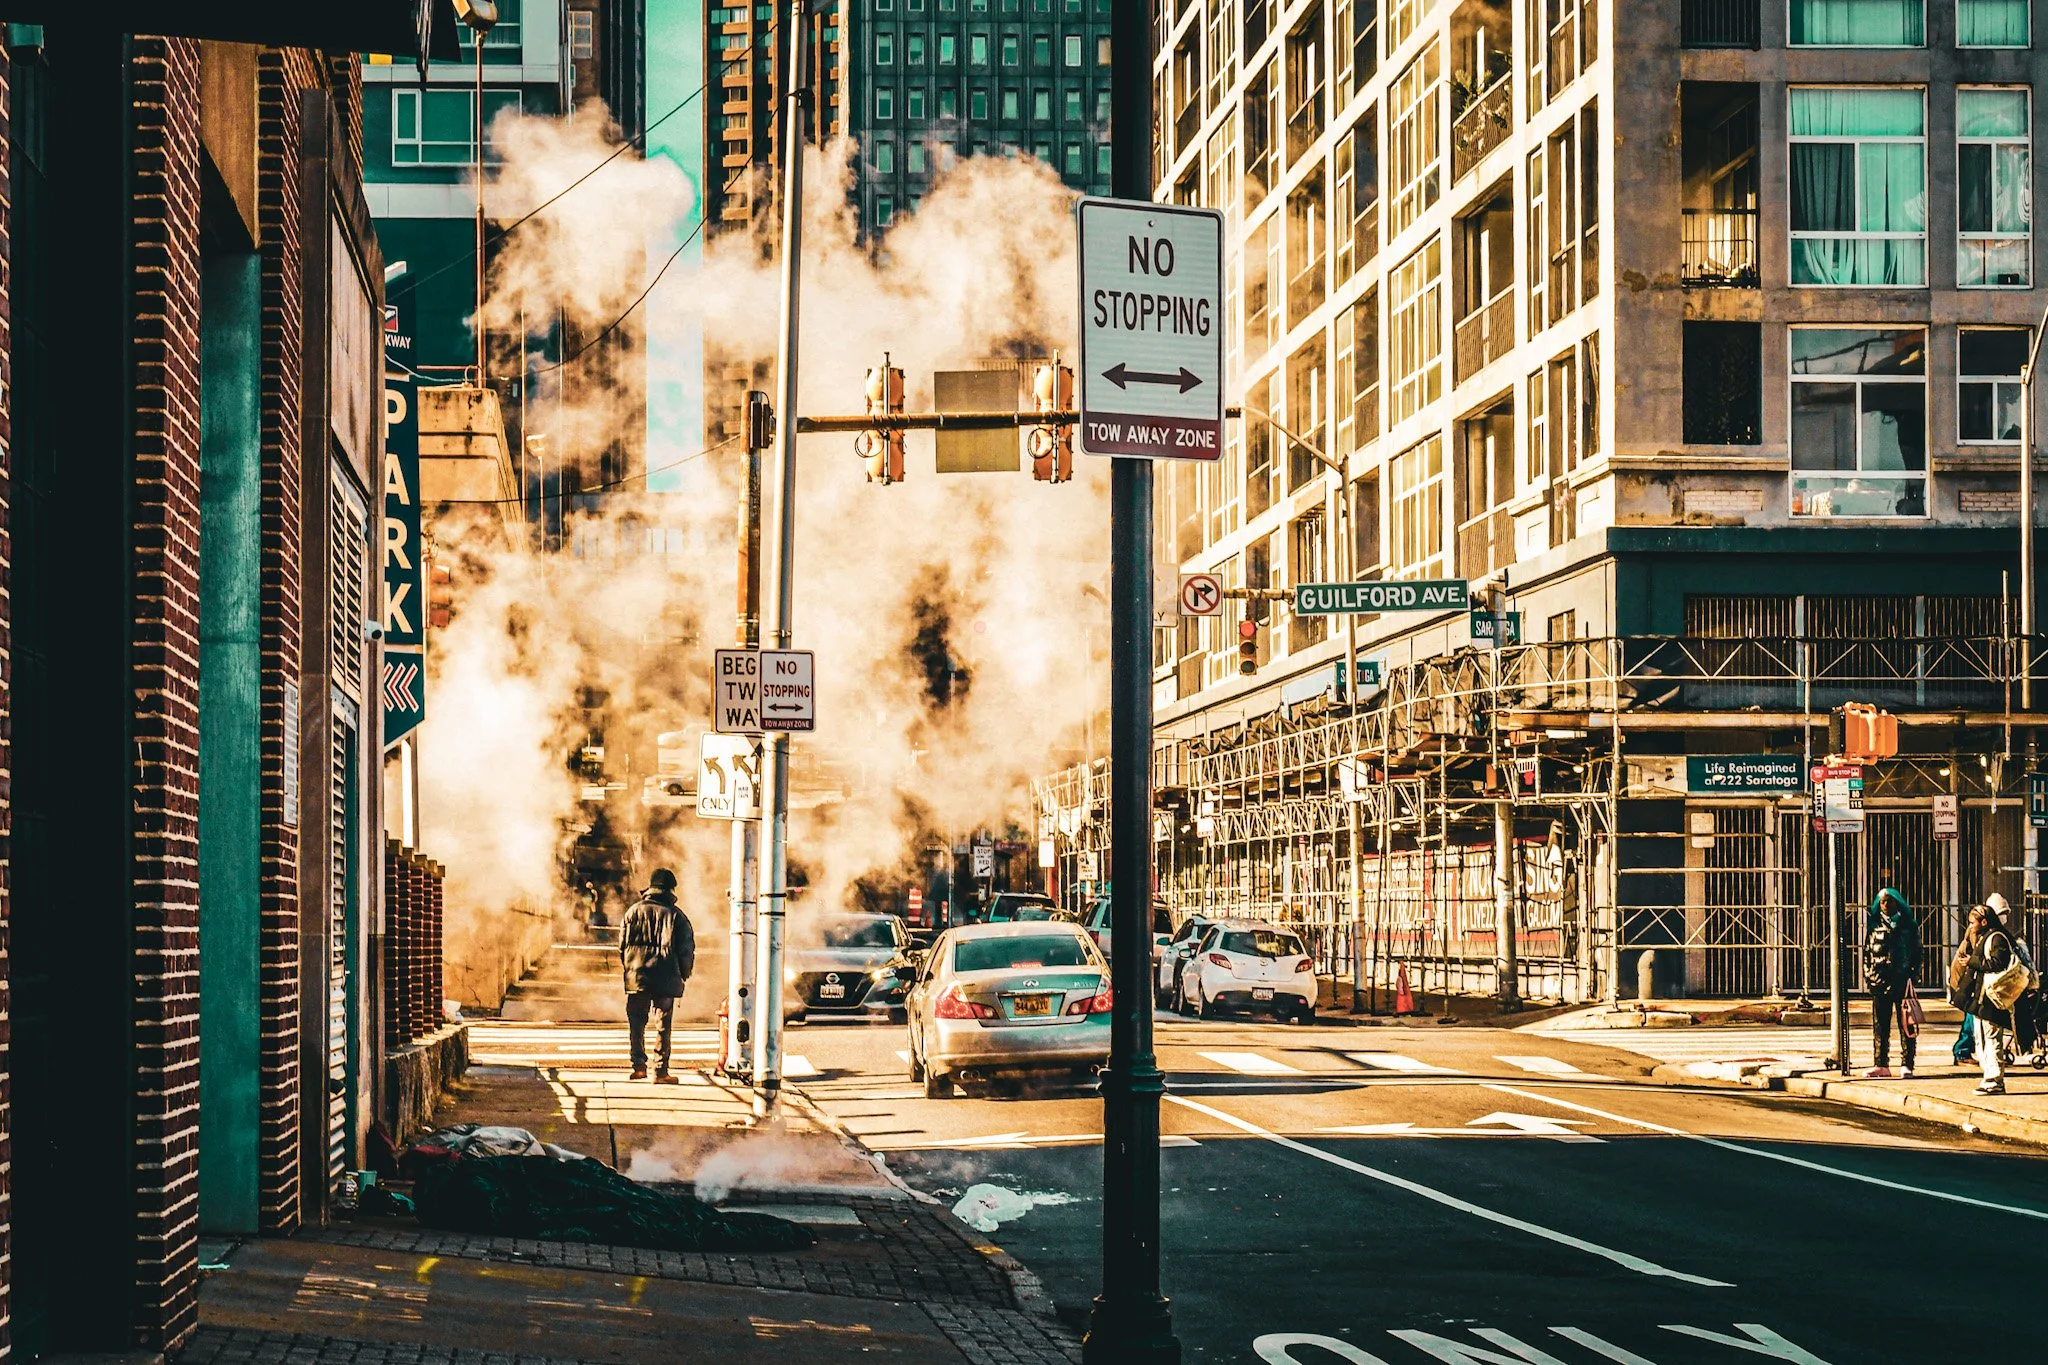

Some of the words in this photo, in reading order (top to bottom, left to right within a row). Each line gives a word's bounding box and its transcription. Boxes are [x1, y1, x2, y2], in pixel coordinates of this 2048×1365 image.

[1128, 235, 1175, 277] NO
[1093, 289, 1210, 337] STOPPING
[1089, 422, 1121, 442] TOW
[1126, 426, 1170, 446] AWAY
[1175, 428, 1216, 449] ZONE
[384, 388, 414, 634] PARK
[1301, 586, 1416, 610] GUILFORD
[1422, 586, 1466, 603] AVE.
[1475, 620, 1515, 637] SARGA
[776, 660, 798, 675] NO
[763, 684, 810, 698] STOPPING
[726, 708, 758, 726] WA
[794, 720, 809, 728] ZONE
[1705, 762, 1725, 774] Life
[1729, 761, 1796, 775] Reimagined
[1720, 775, 1742, 786] 222
[1746, 775, 1798, 787] Saratoga
[702, 797, 731, 811] ONLY
[1850, 800, 1862, 808] 115
[2033, 780, 2045, 812] H
[1935, 810, 1956, 818] STOPPING
